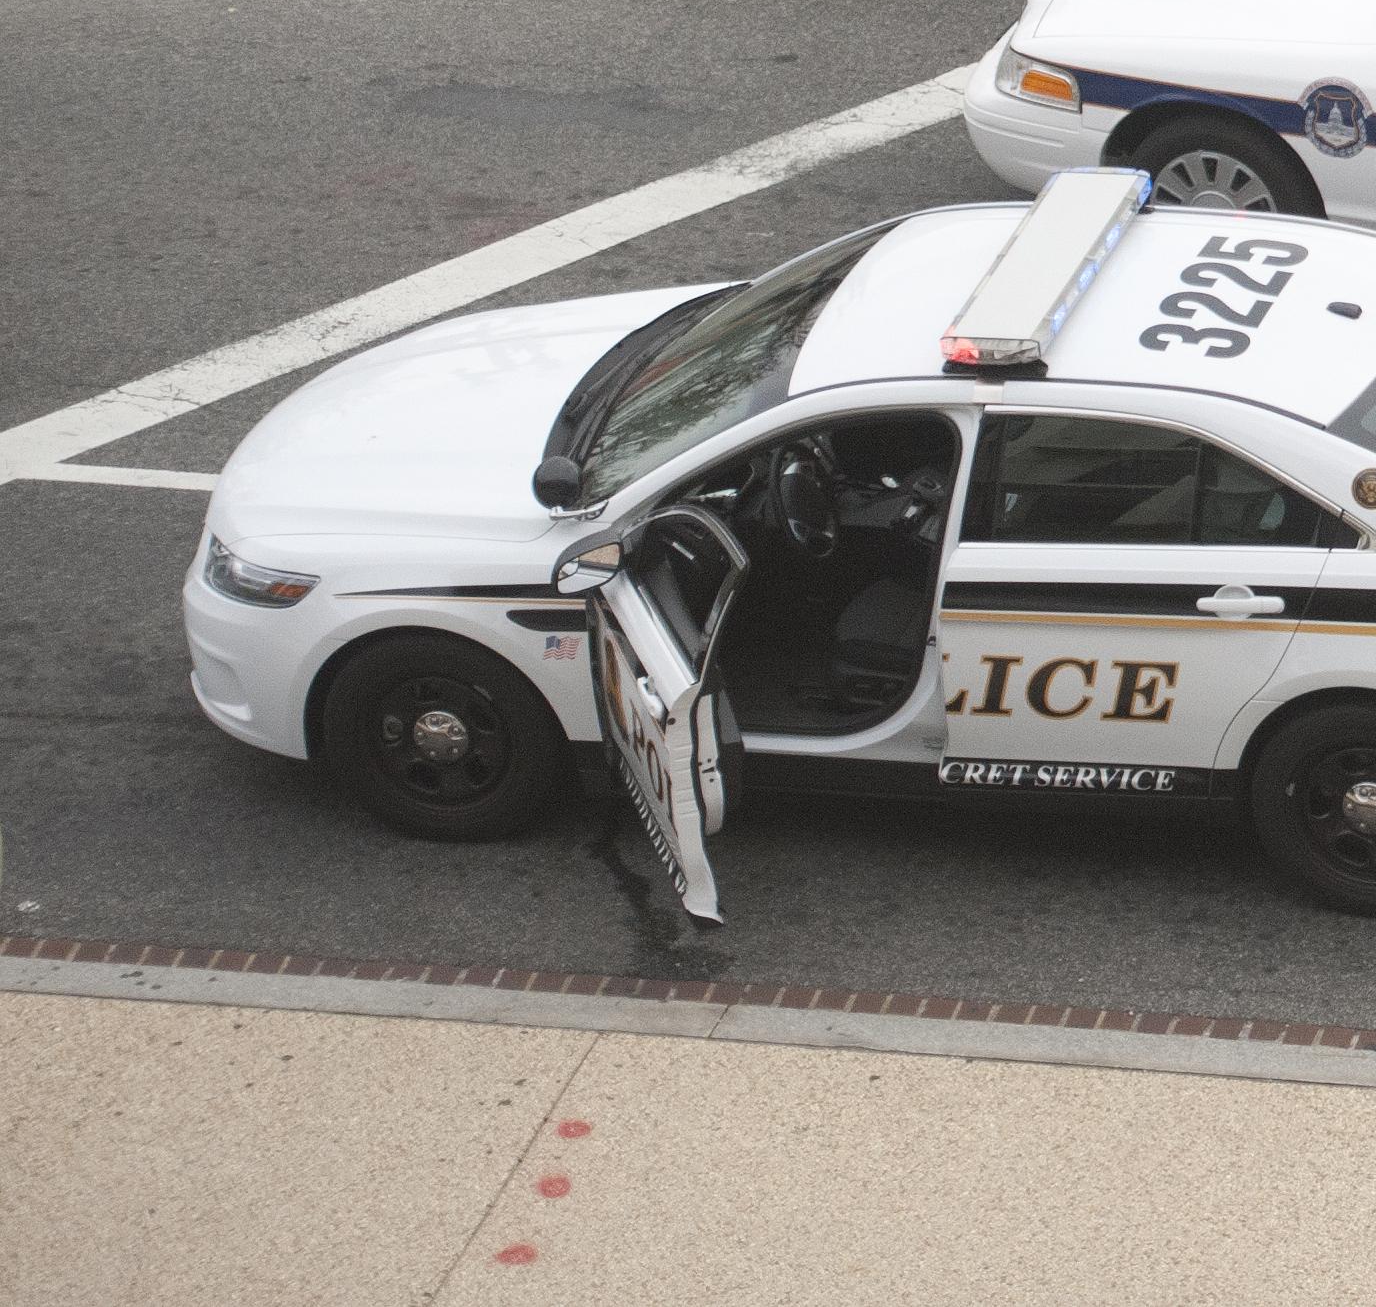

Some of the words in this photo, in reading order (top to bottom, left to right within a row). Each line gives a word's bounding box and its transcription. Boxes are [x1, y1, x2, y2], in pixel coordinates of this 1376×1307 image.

[1138, 235, 1309, 359] 3225
[942, 652, 1180, 724] ICE
[940, 761, 1031, 786] CRET
[1034, 764, 1176, 792] SERVICE
